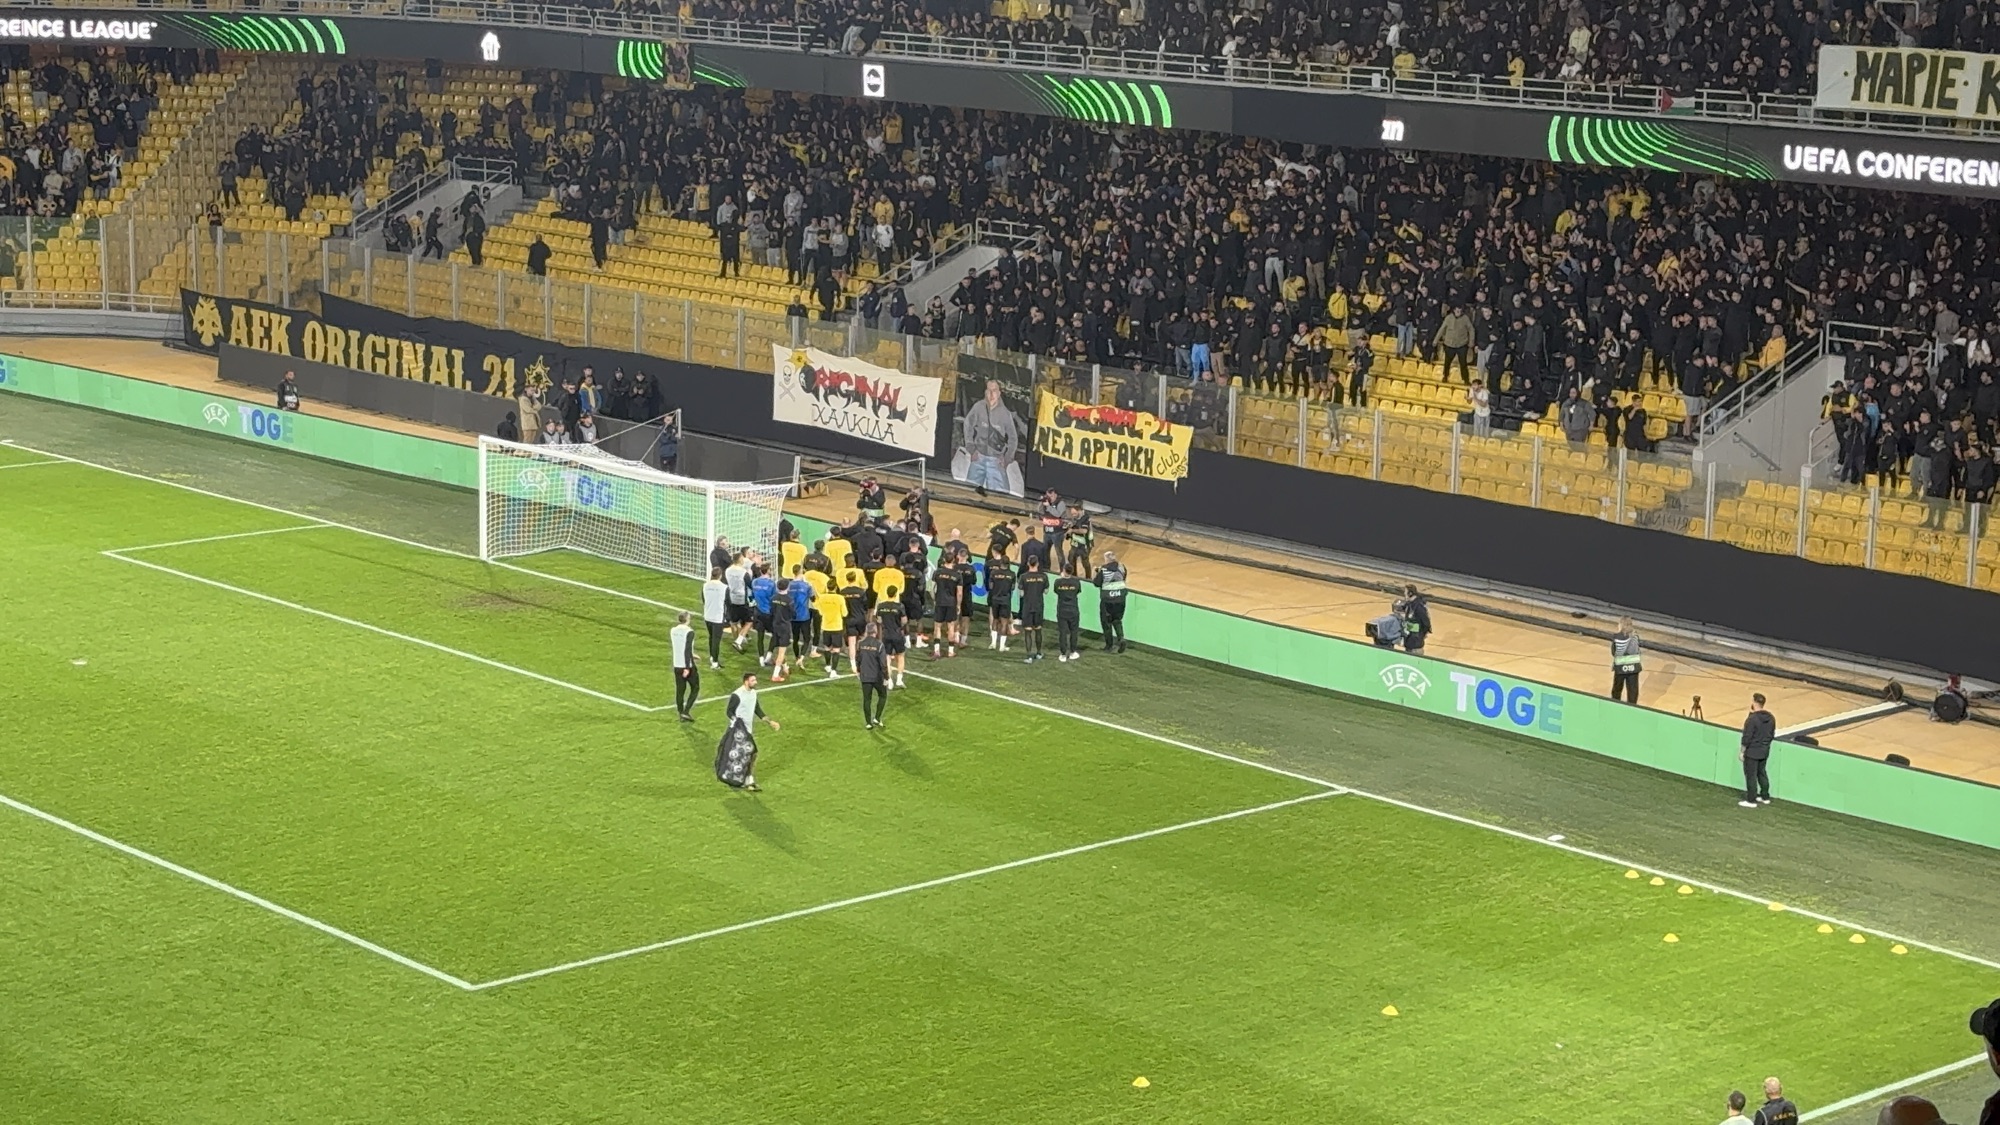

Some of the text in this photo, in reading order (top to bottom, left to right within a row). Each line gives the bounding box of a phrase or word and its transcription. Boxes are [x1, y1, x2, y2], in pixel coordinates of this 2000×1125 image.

[1784, 145, 2000, 187] UEFA CONFEREN
[229, 305, 517, 399] AEK ORIGINAL 21
[203, 405, 294, 443] UEFA TOGE
[812, 404, 898, 444] ΧΑΛΚΙΔΑ
[1079, 437, 1155, 476] ΑΡΤΑΚΗ
[1381, 668, 1564, 735] UEFA TOGE
